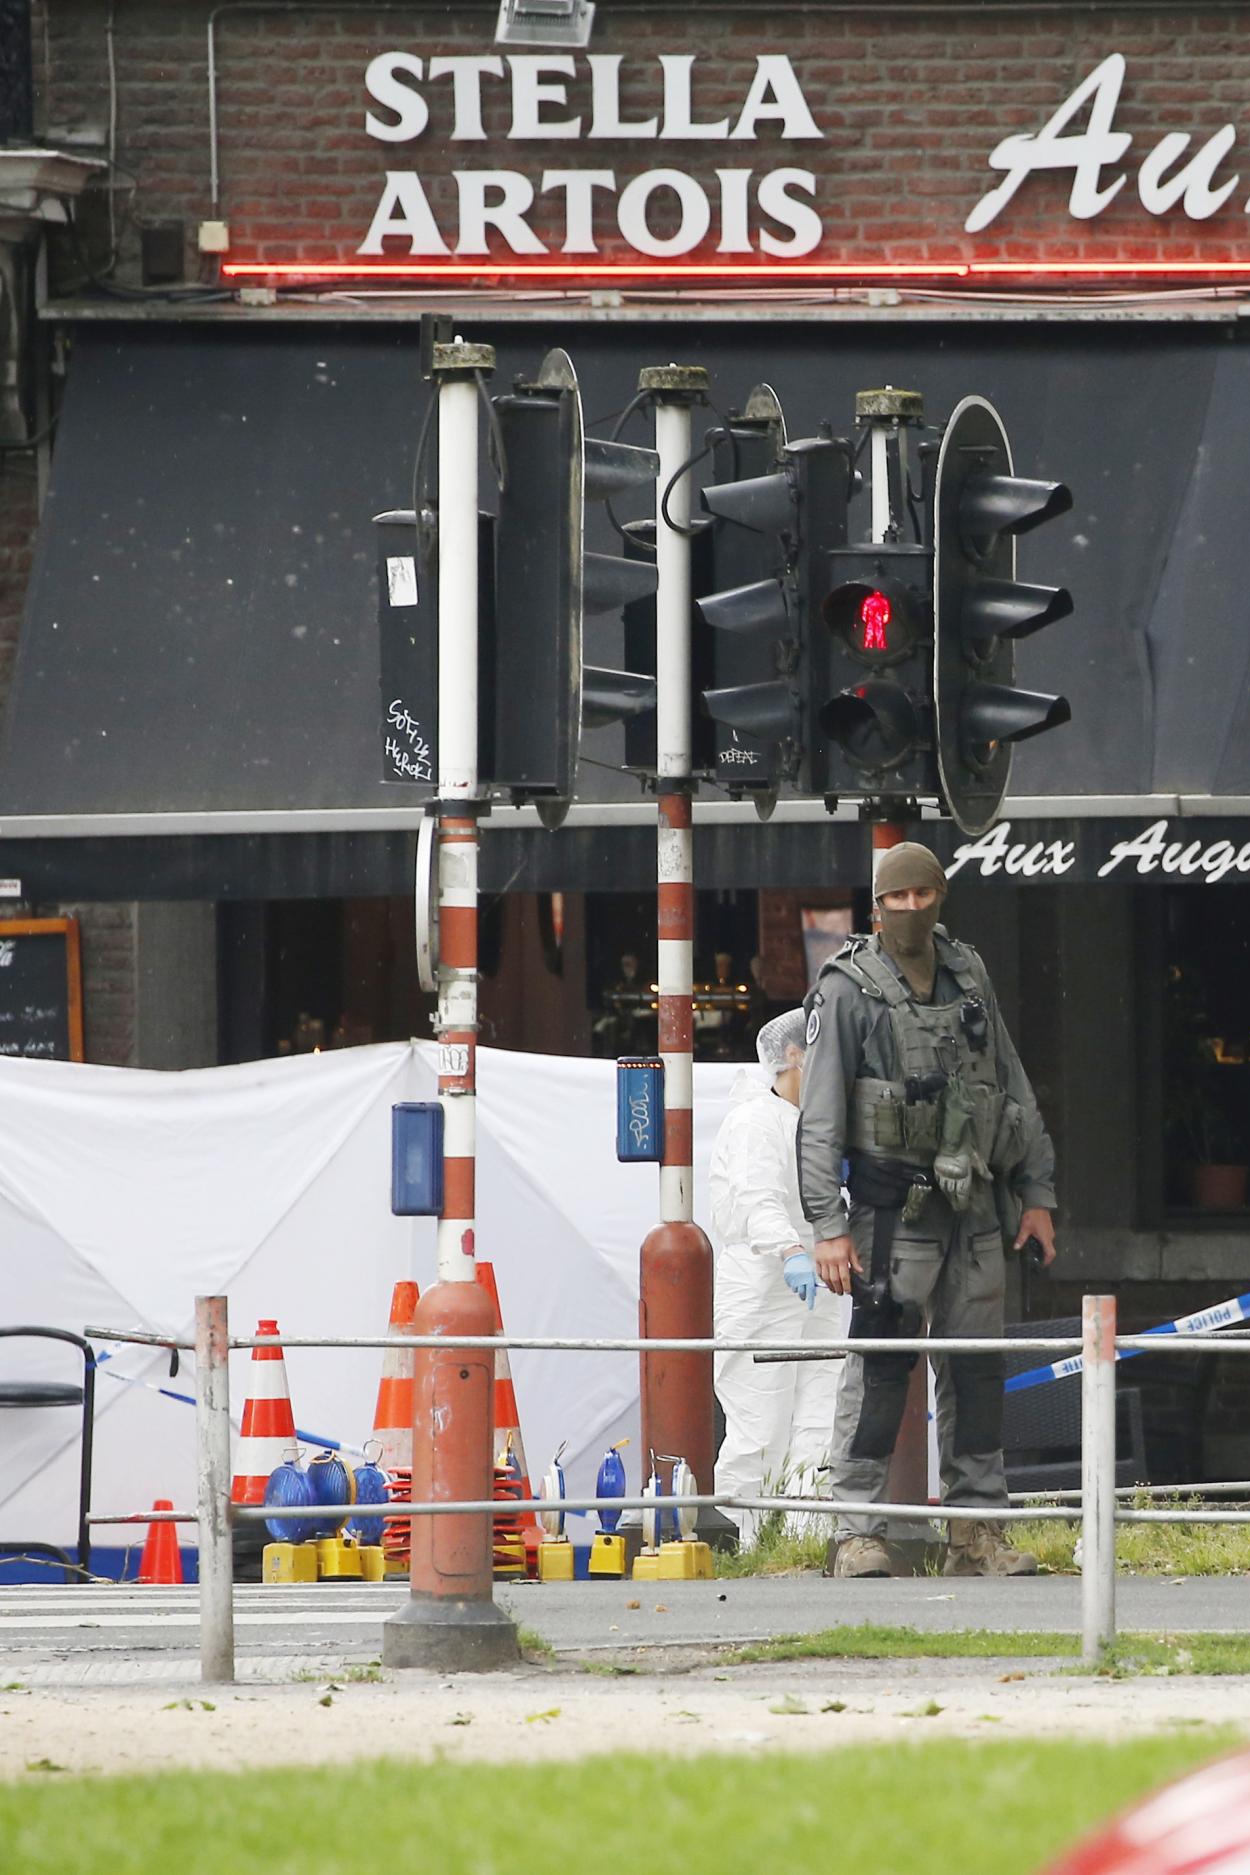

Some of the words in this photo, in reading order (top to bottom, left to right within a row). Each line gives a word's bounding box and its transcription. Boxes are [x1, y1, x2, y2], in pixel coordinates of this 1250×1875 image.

[364, 51, 824, 143] STELLA
[356, 167, 823, 258] ARTOIS
[944, 821, 1076, 880] Aux
